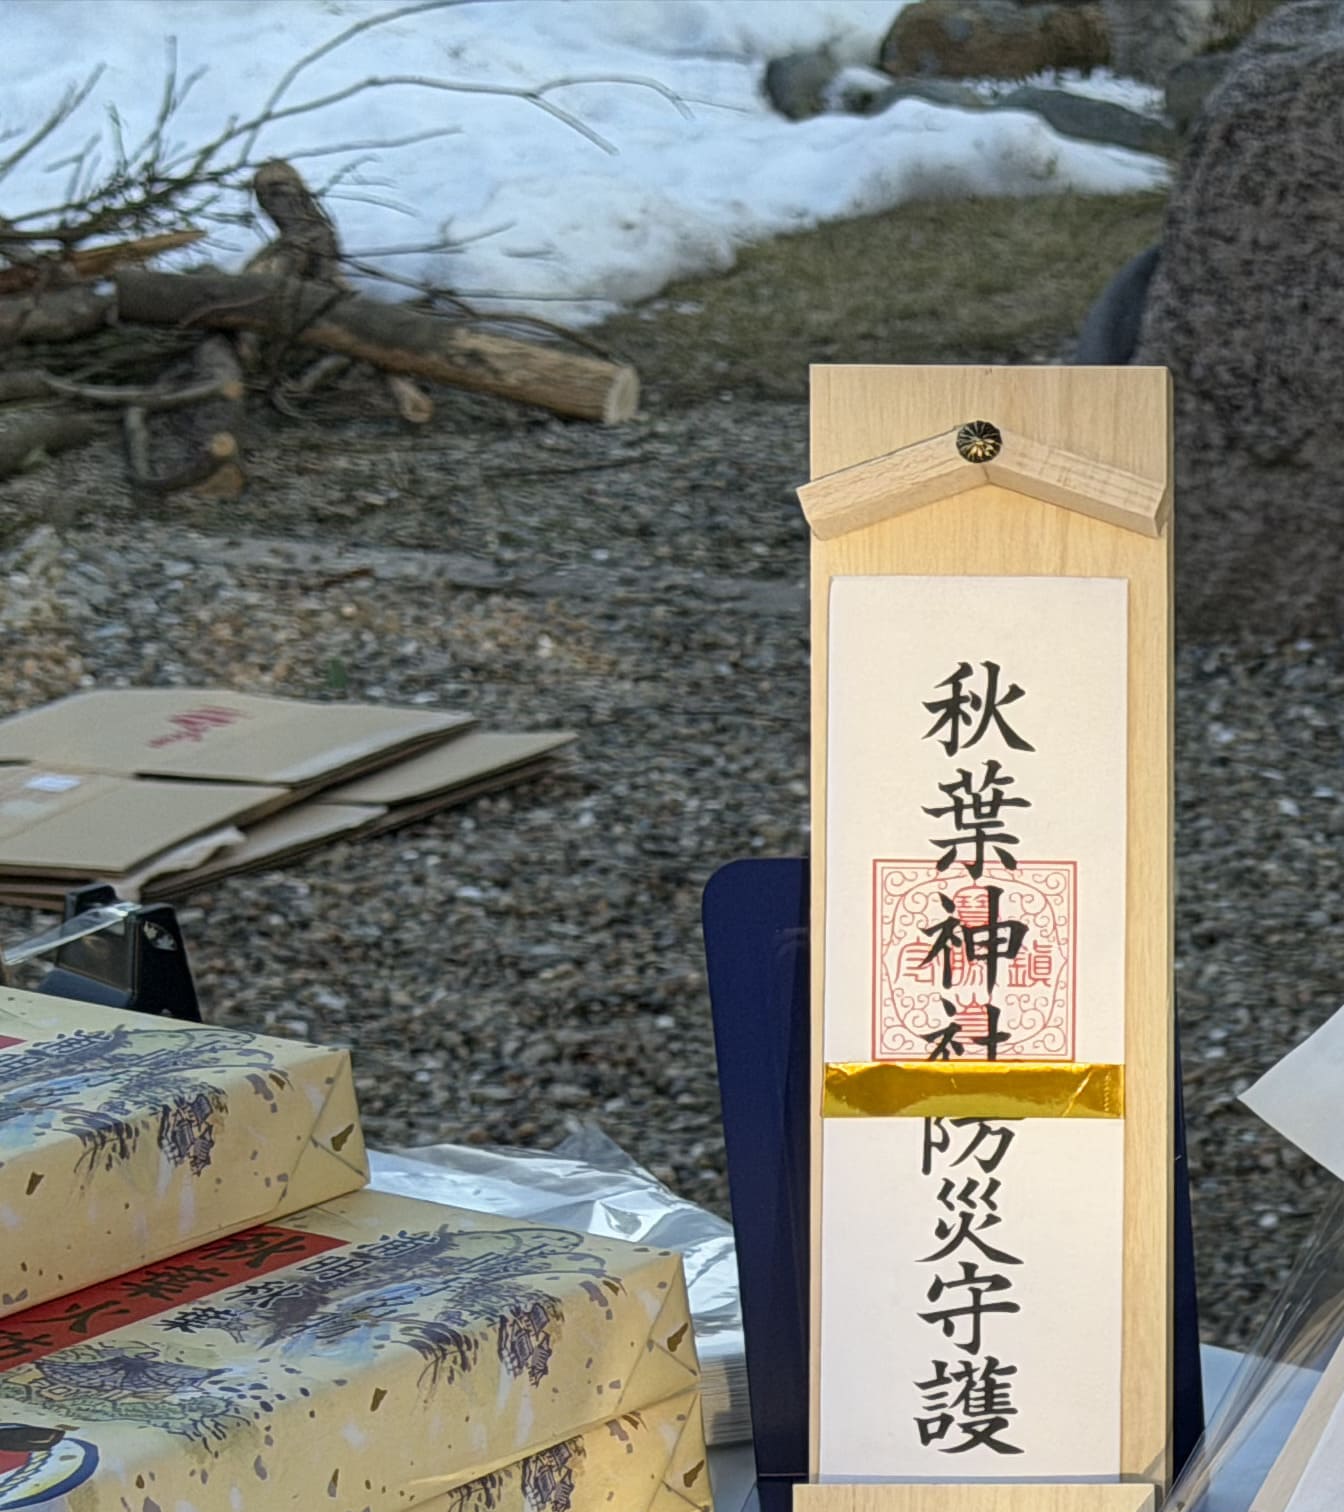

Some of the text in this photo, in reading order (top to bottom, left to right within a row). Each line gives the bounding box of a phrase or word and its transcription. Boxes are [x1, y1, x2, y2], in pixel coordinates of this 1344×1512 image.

[913, 660, 1036, 1456] 秋葉神社防災守護
